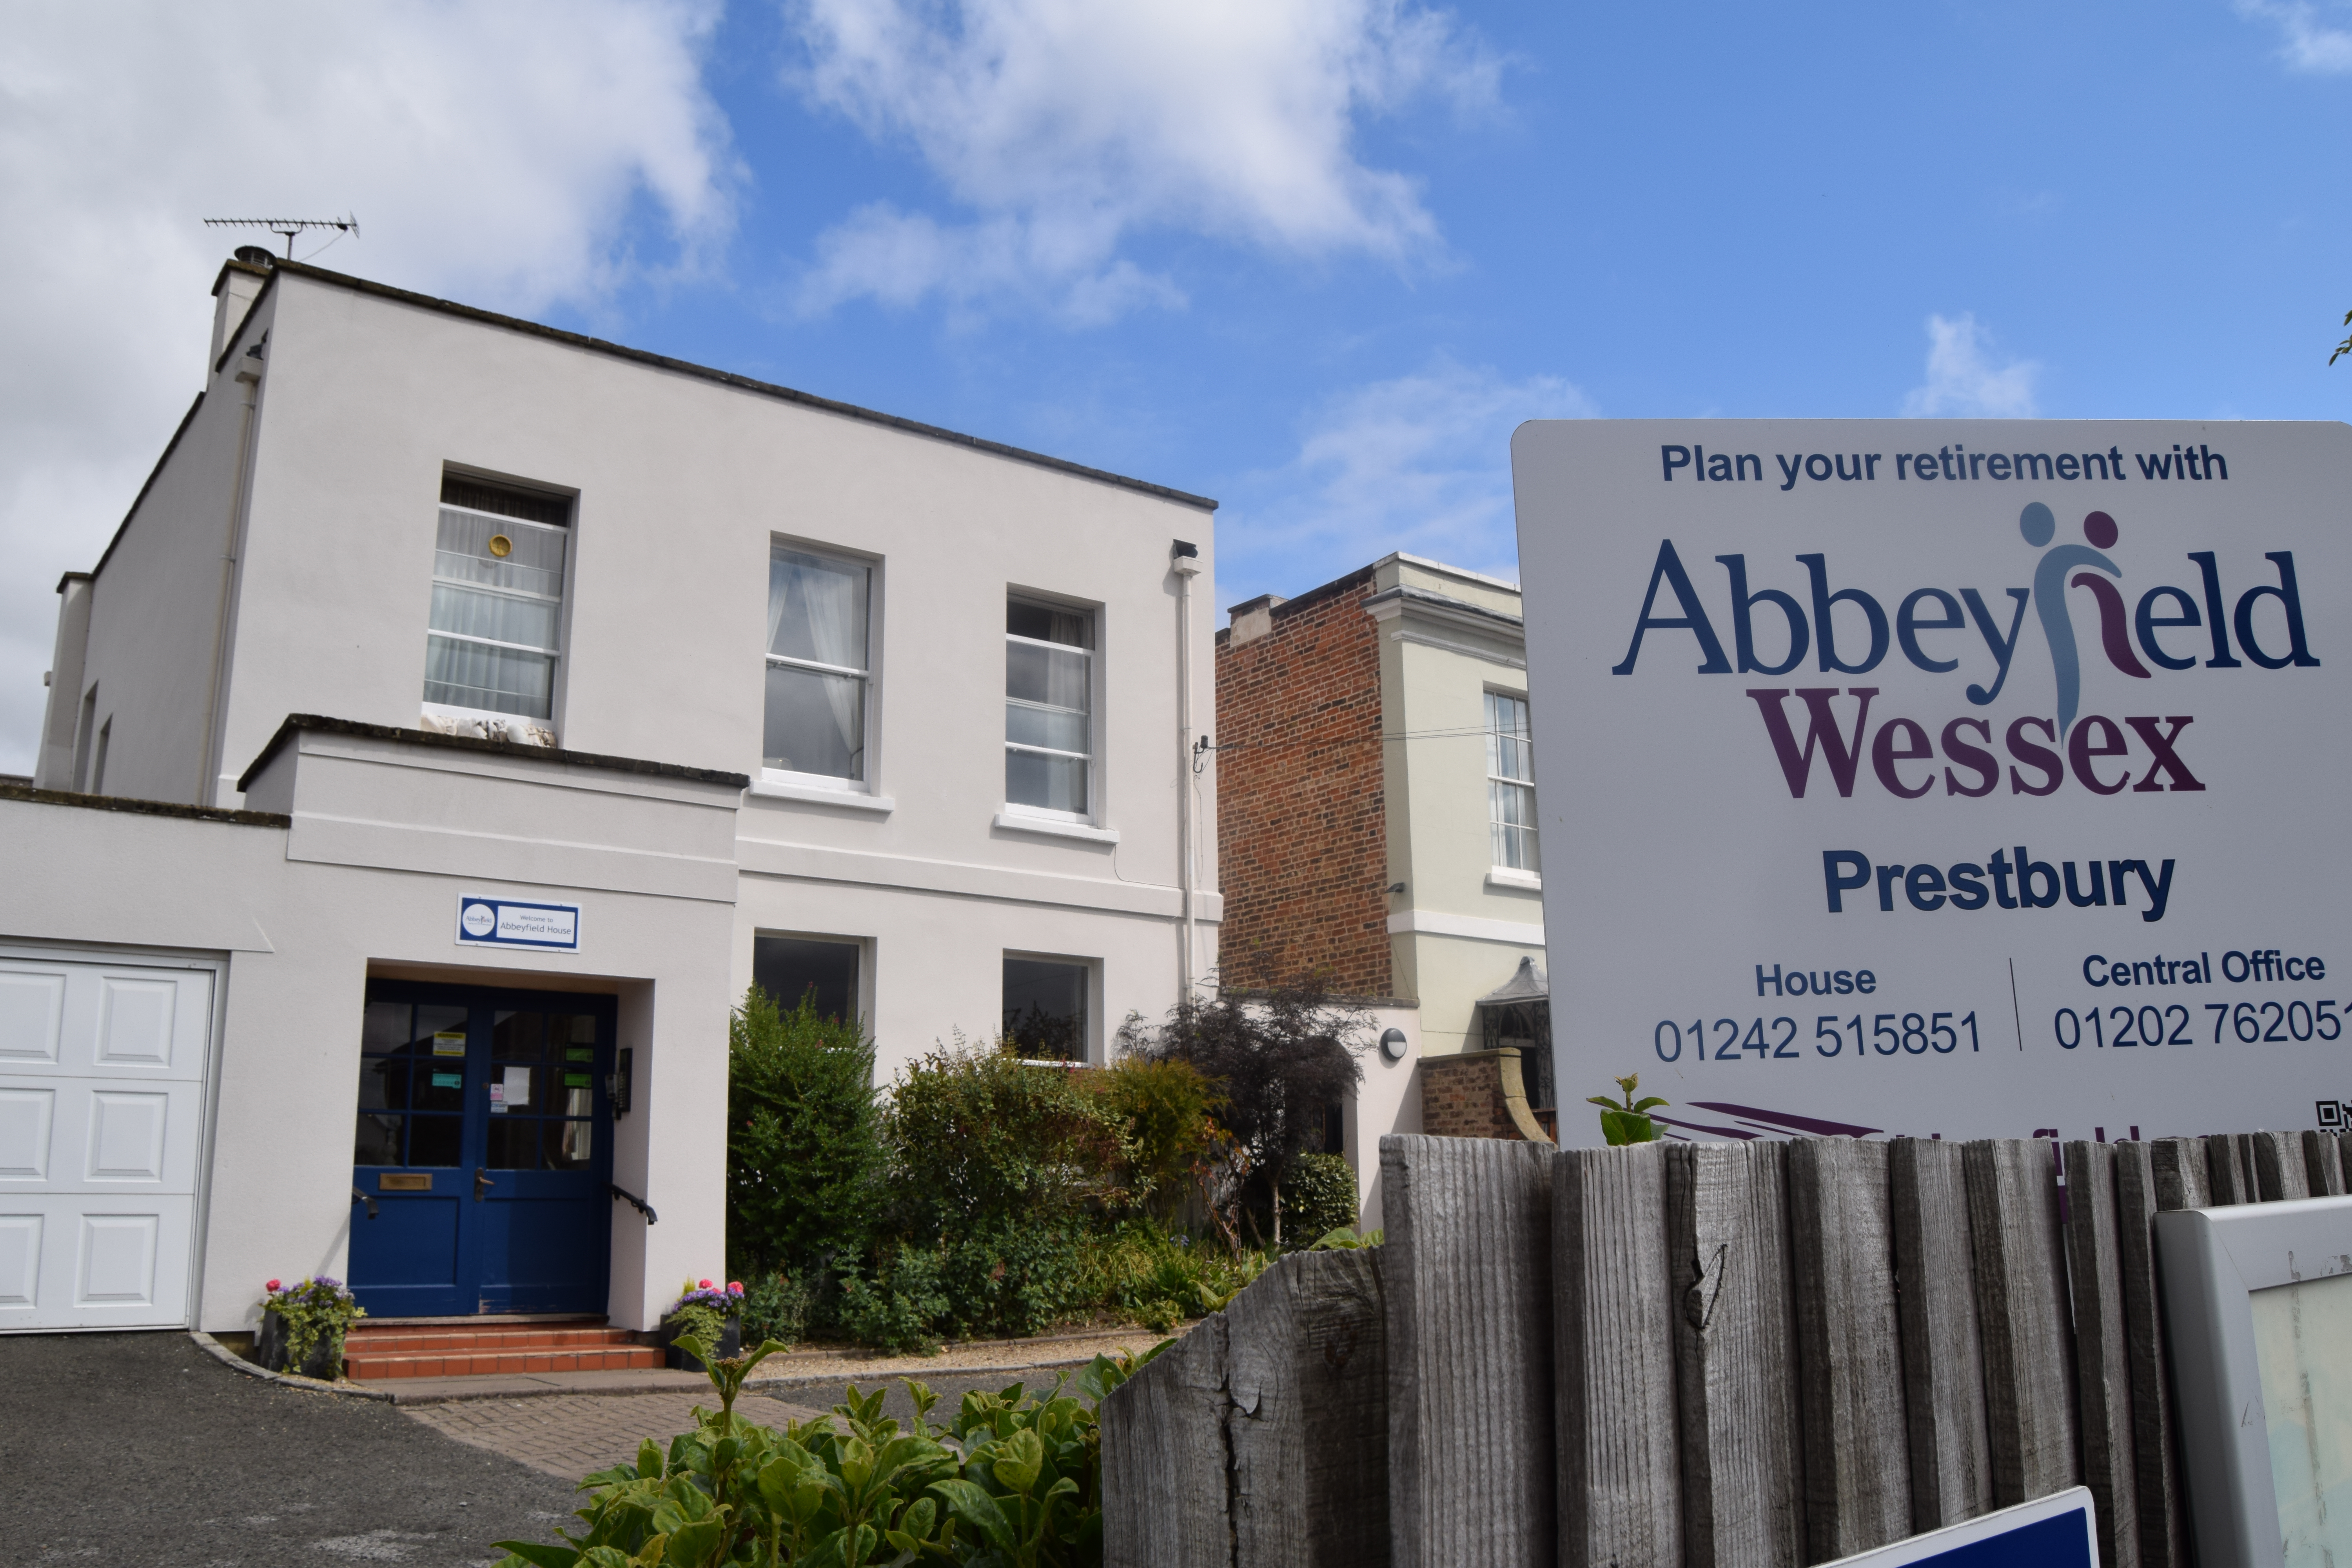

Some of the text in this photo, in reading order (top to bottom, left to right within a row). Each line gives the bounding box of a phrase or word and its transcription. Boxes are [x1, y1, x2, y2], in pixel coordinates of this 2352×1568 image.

[1662, 445, 2228, 491] Plan your retirement with
[1612, 502, 2321, 749] Abbeyfield
[1746, 688, 2206, 799] Wessex
[1823, 846, 2175, 922] Prestbury
[500, 922, 571, 935] Abbeyfield House
[1756, 964, 1876, 996] House
[2083, 950, 2325, 987] Central Office
[1655, 1011, 1979, 1062] 01242 515851
[2055, 1005, 2192, 1049] 01202
